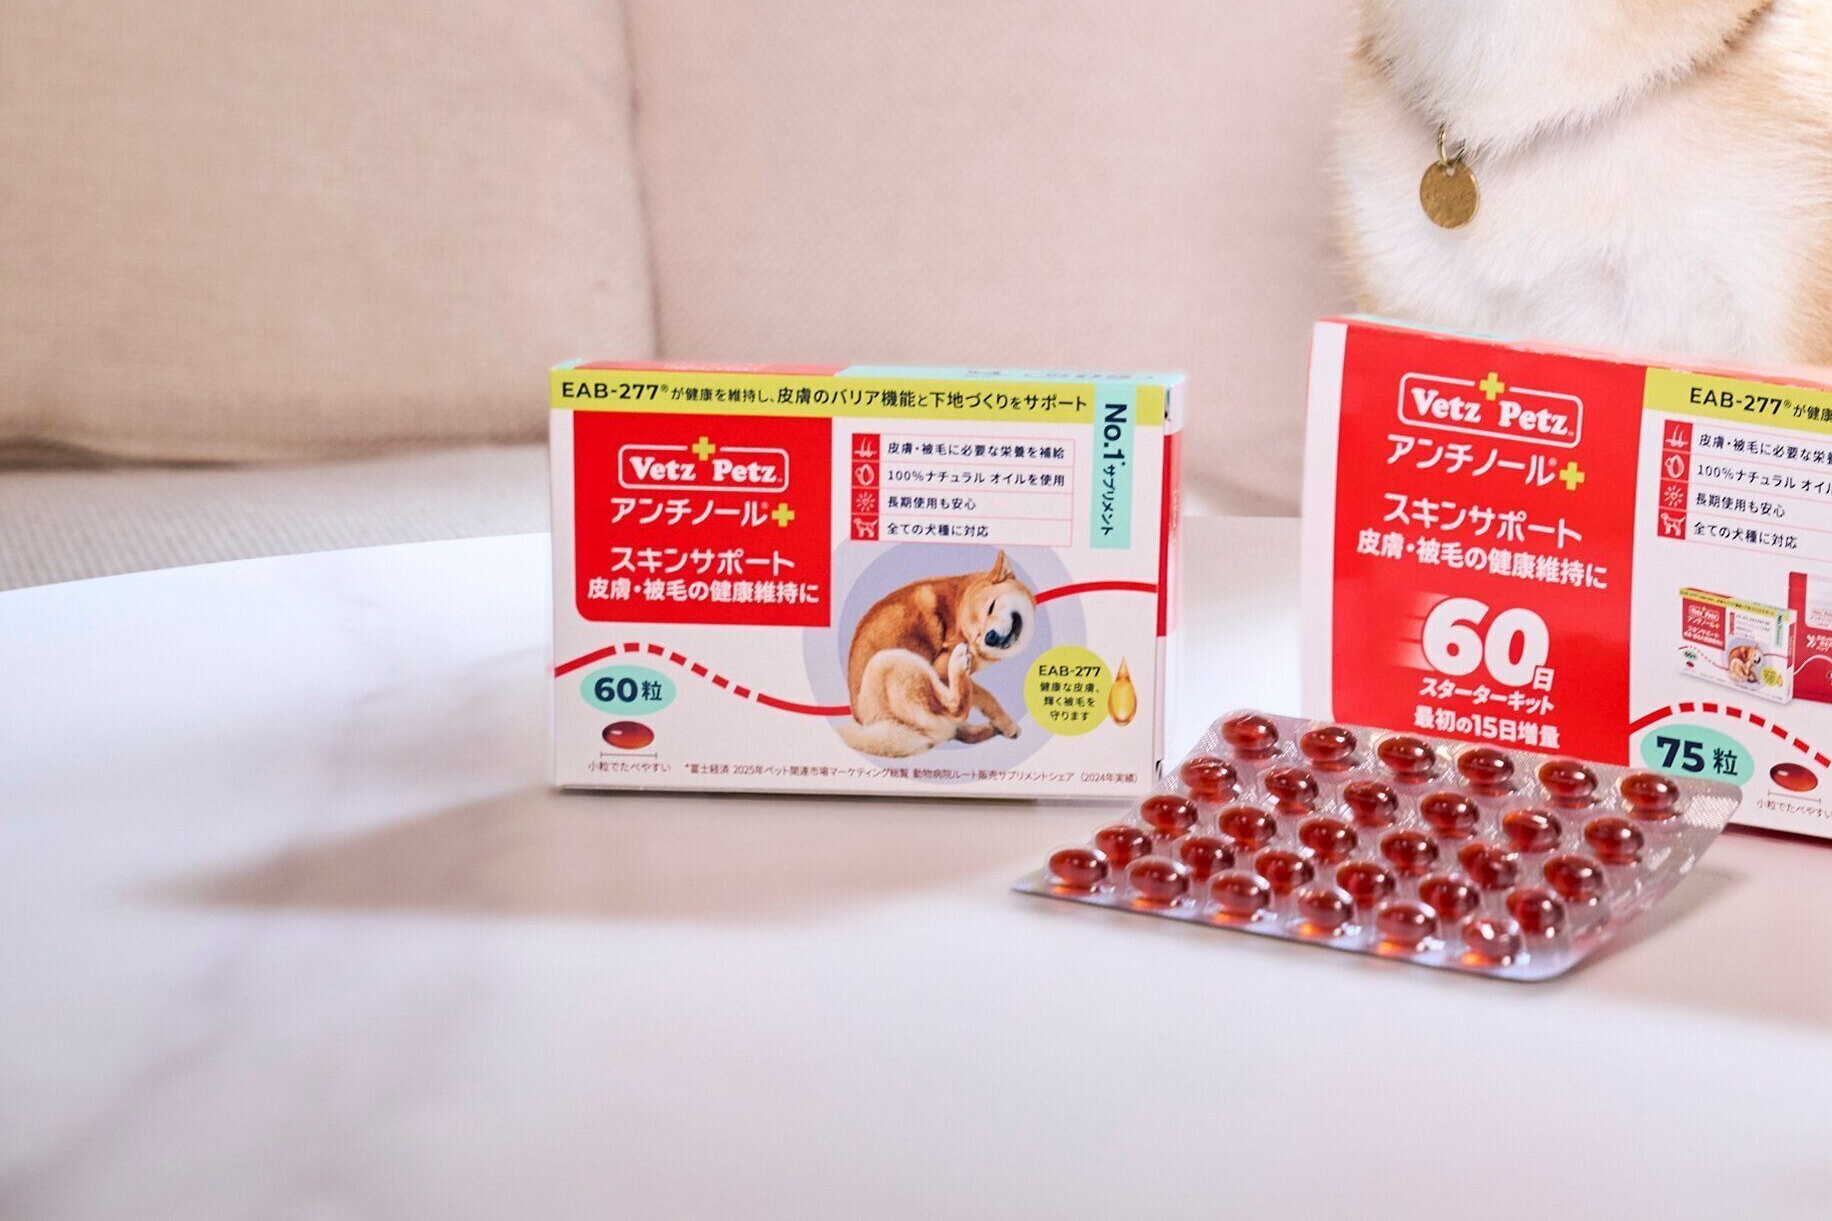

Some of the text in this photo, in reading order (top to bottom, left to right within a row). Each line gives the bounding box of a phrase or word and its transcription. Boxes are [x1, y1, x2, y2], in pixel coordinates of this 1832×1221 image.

[1411, 387, 1569, 436] Vetz Petz
[887, 441, 1065, 460] 皮膚・被毛に必要な栄養を補給
[630, 456, 777, 483] Vetz Petz
[888, 469, 1065, 487] 100%ナチュラル オイルを使用
[1697, 464, 1796, 490] 100%ナチュラル
[887, 495, 976, 511] 長期使用も安心
[1695, 492, 1786, 518] 長期使用も安心
[887, 522, 989, 538] 全ての犬種に対応
[1383, 492, 1582, 549] スキンサポート
[1693, 521, 1798, 550] 全ての犬種に対応
[611, 547, 795, 576] スキンサポート
[1357, 527, 1608, 589] 皮膚・被毛の健康維持に
[587, 577, 819, 604] 皮膚・被毛の健康維持に
[1038, 665, 1101, 678] EAB-277
[594, 677, 663, 703] 60粒
[1418, 677, 1555, 716] スターターキット
[1049, 710, 1090, 722] 守ります
[1414, 704, 1561, 750] 最初の15日増量
[588, 761, 671, 773] 小粒でたべやすい
[1656, 735, 1738, 776] 75粒
